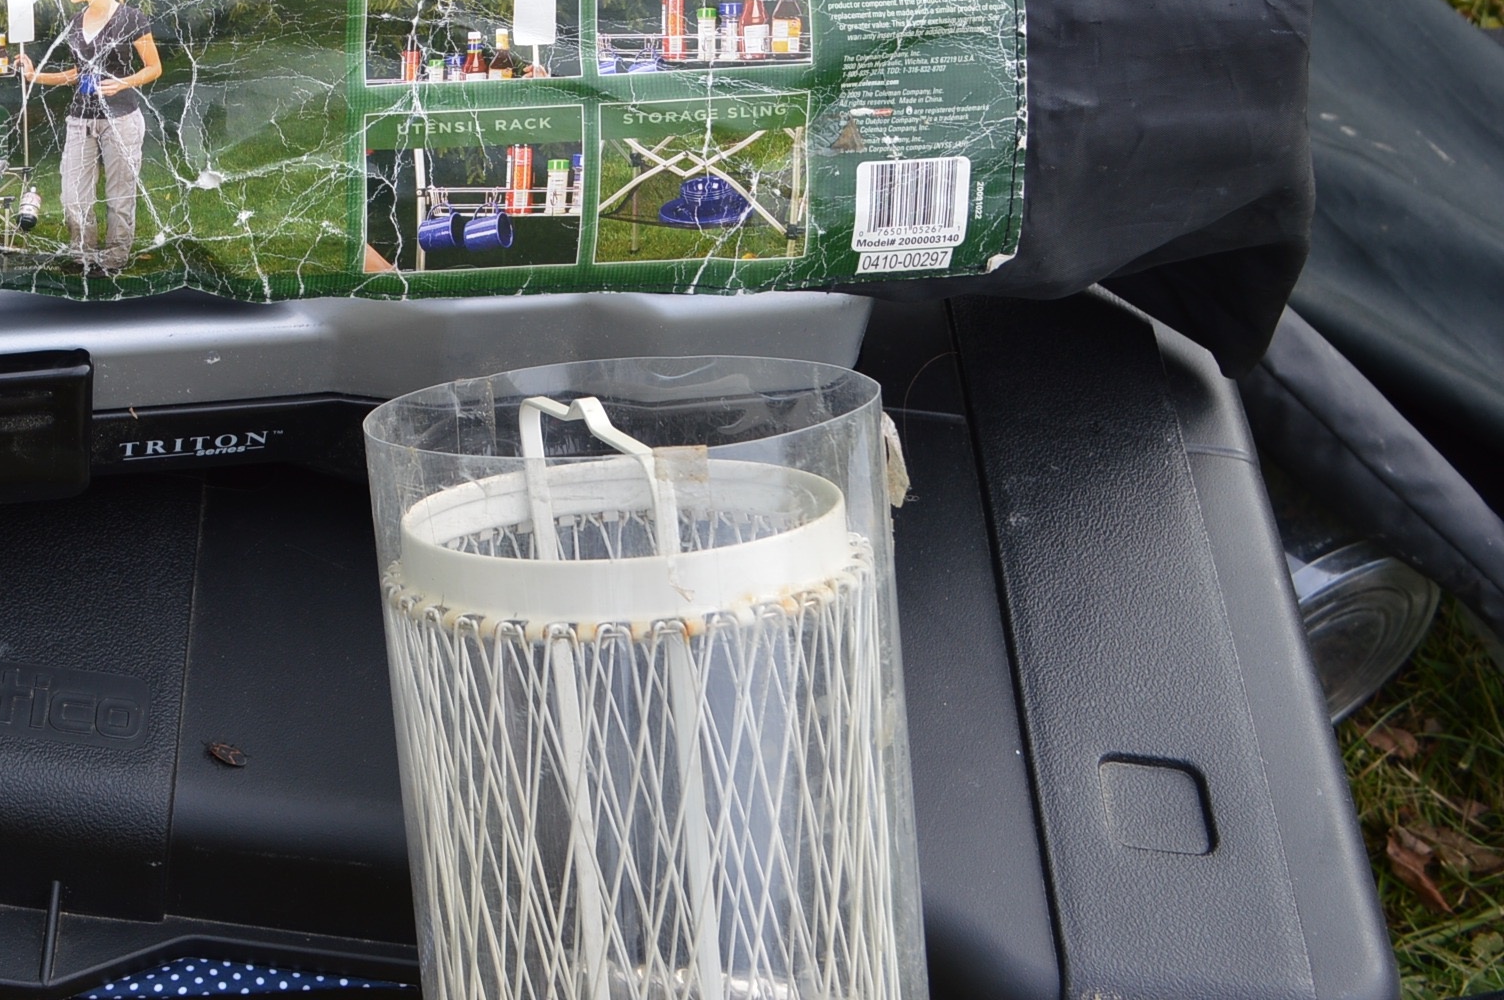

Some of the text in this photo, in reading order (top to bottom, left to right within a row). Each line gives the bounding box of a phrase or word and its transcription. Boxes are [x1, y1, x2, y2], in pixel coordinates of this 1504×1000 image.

[828, 0, 852, 11] product
[861, 0, 898, 8] component.
[830, 10, 870, 21] replacement
[872, 10, 886, 19] may
[886, 8, 894, 16] be
[895, 7, 912, 16] made
[935, 5, 956, 14] similar
[891, 18, 904, 27] This
[843, 54, 854, 62] The
[904, 57, 929, 65] Wichita,
[930, 56, 939, 64] KS
[940, 55, 956, 63] 67219
[840, 78, 899, 87] www.coleman.com
[874, 88, 901, 97] Coleman
[902, 87, 931, 96] Company,
[848, 99, 866, 108] rights
[866, 97, 895, 106] reserved.
[898, 96, 916, 104] Made
[924, 95, 944, 103] China.
[623, 104, 787, 125] STORAGE SLING
[924, 105, 956, 115] registered
[864, 116, 890, 124] Outdoor
[938, 113, 968, 121] trademark
[397, 117, 552, 135] UTENSIL RACK
[859, 125, 886, 133] Coleman
[888, 124, 918, 133] Company,
[877, 227, 907, 236] 76501
[912, 225, 943, 235] 05267
[856, 234, 960, 248] Model# 2000003140
[862, 250, 949, 271] 0410-00297
[119, 430, 269, 457] TRITON
[195, 445, 246, 457] series
